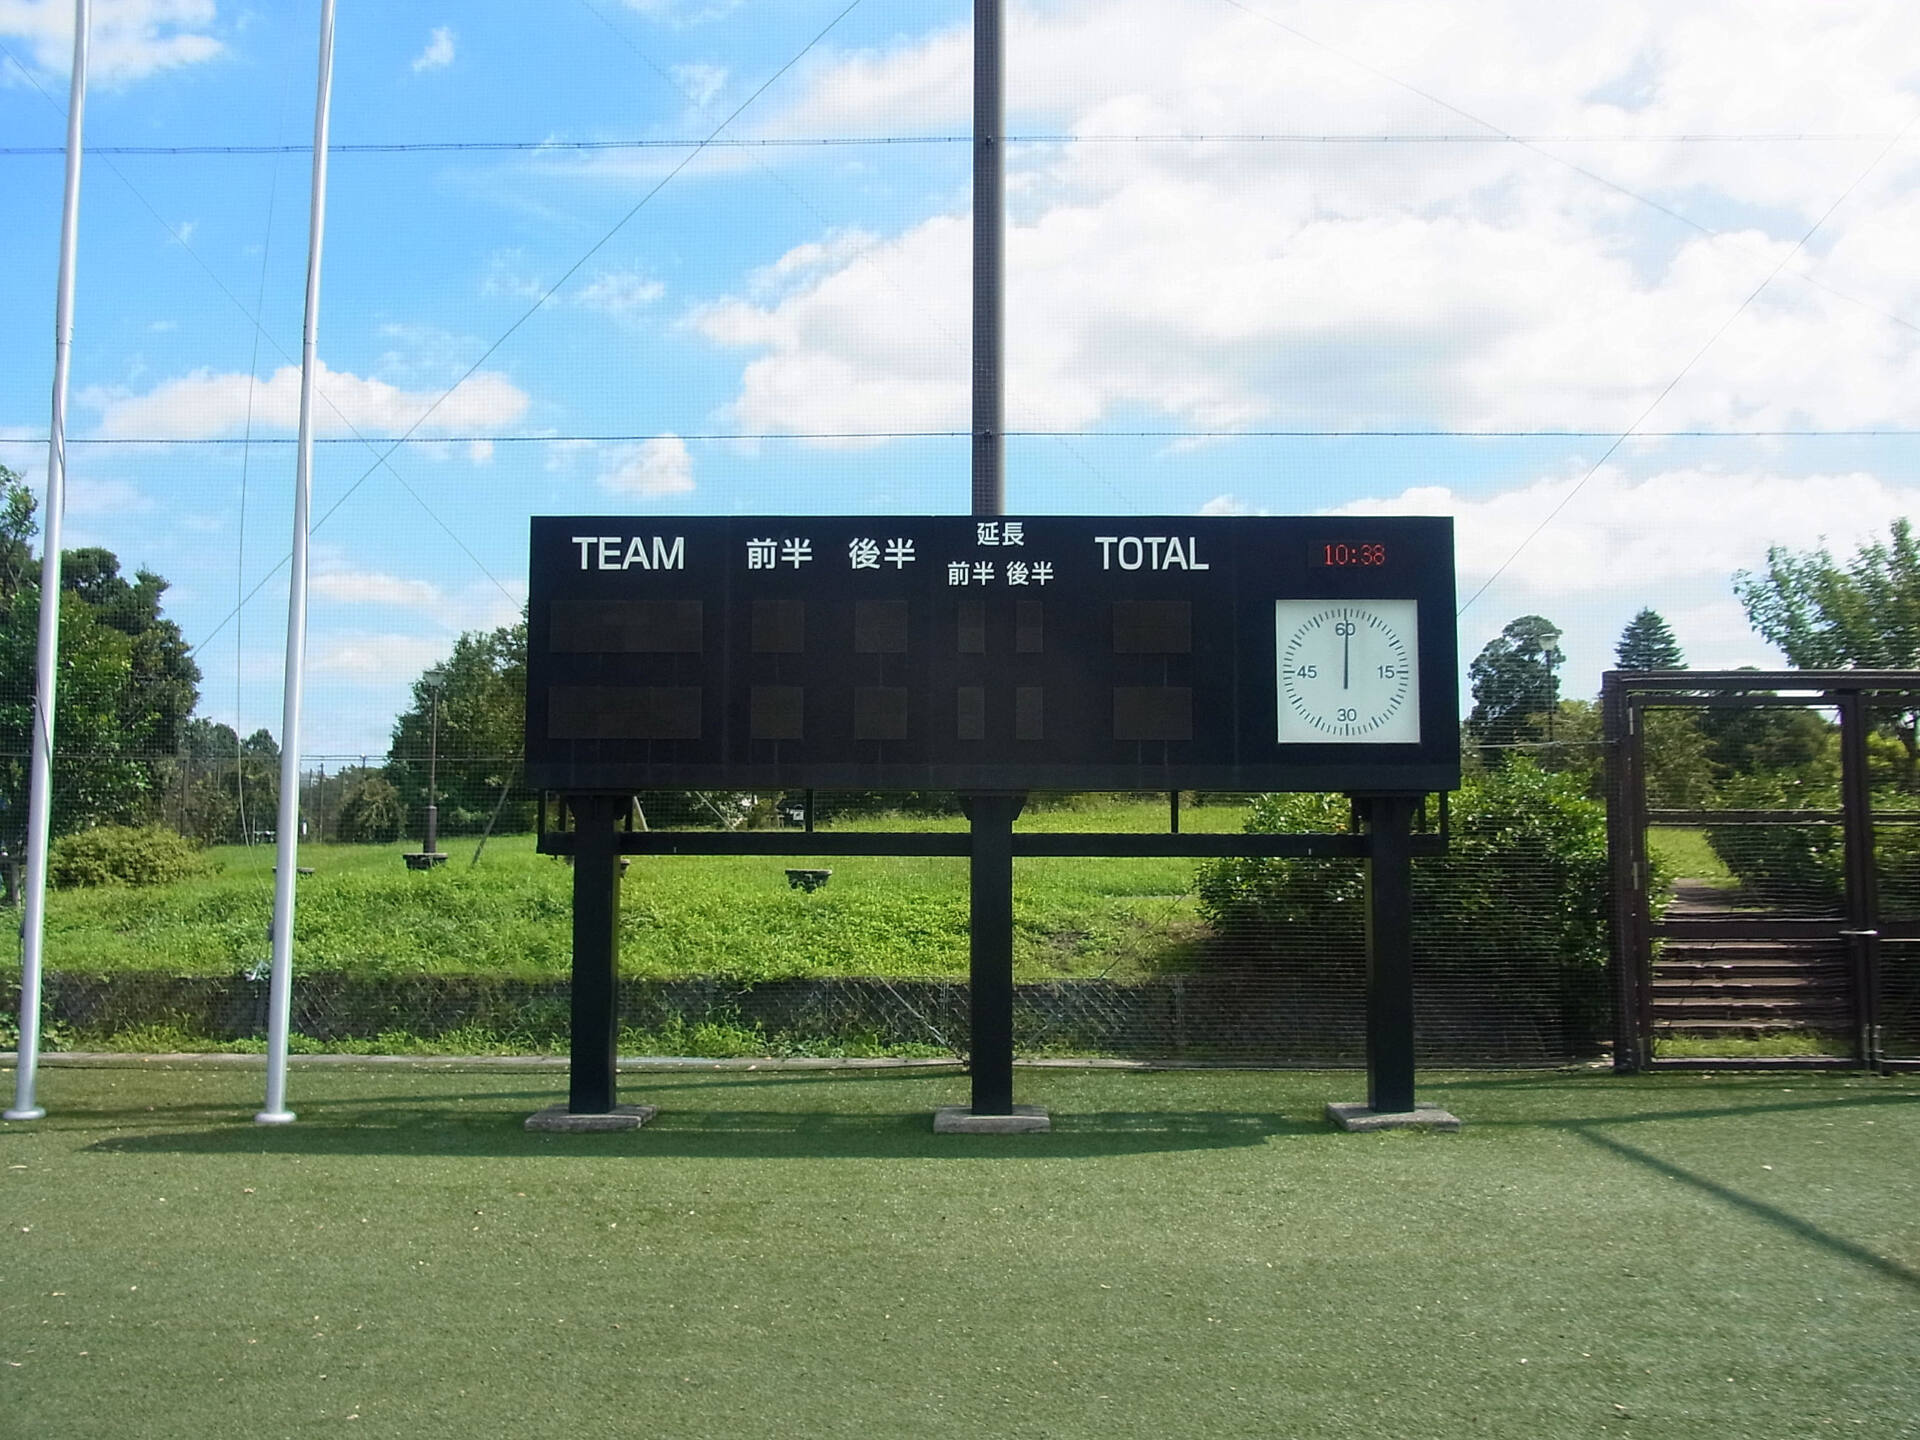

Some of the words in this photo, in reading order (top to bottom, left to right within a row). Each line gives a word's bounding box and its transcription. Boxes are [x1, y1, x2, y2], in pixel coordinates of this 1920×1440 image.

[976, 521, 1025, 546] 延長
[571, 536, 685, 570] TEAM
[746, 537, 813, 570] 前半
[848, 537, 916, 570] 後半
[1094, 536, 1210, 571] TOTAL
[1325, 544, 1386, 566] 10:38
[947, 560, 995, 586] 前半
[1006, 560, 1054, 586] 後半
[1335, 622, 1356, 637] 60
[1296, 665, 1318, 679] 45
[1377, 665, 1395, 679] 15
[1336, 708, 1357, 722] 30
